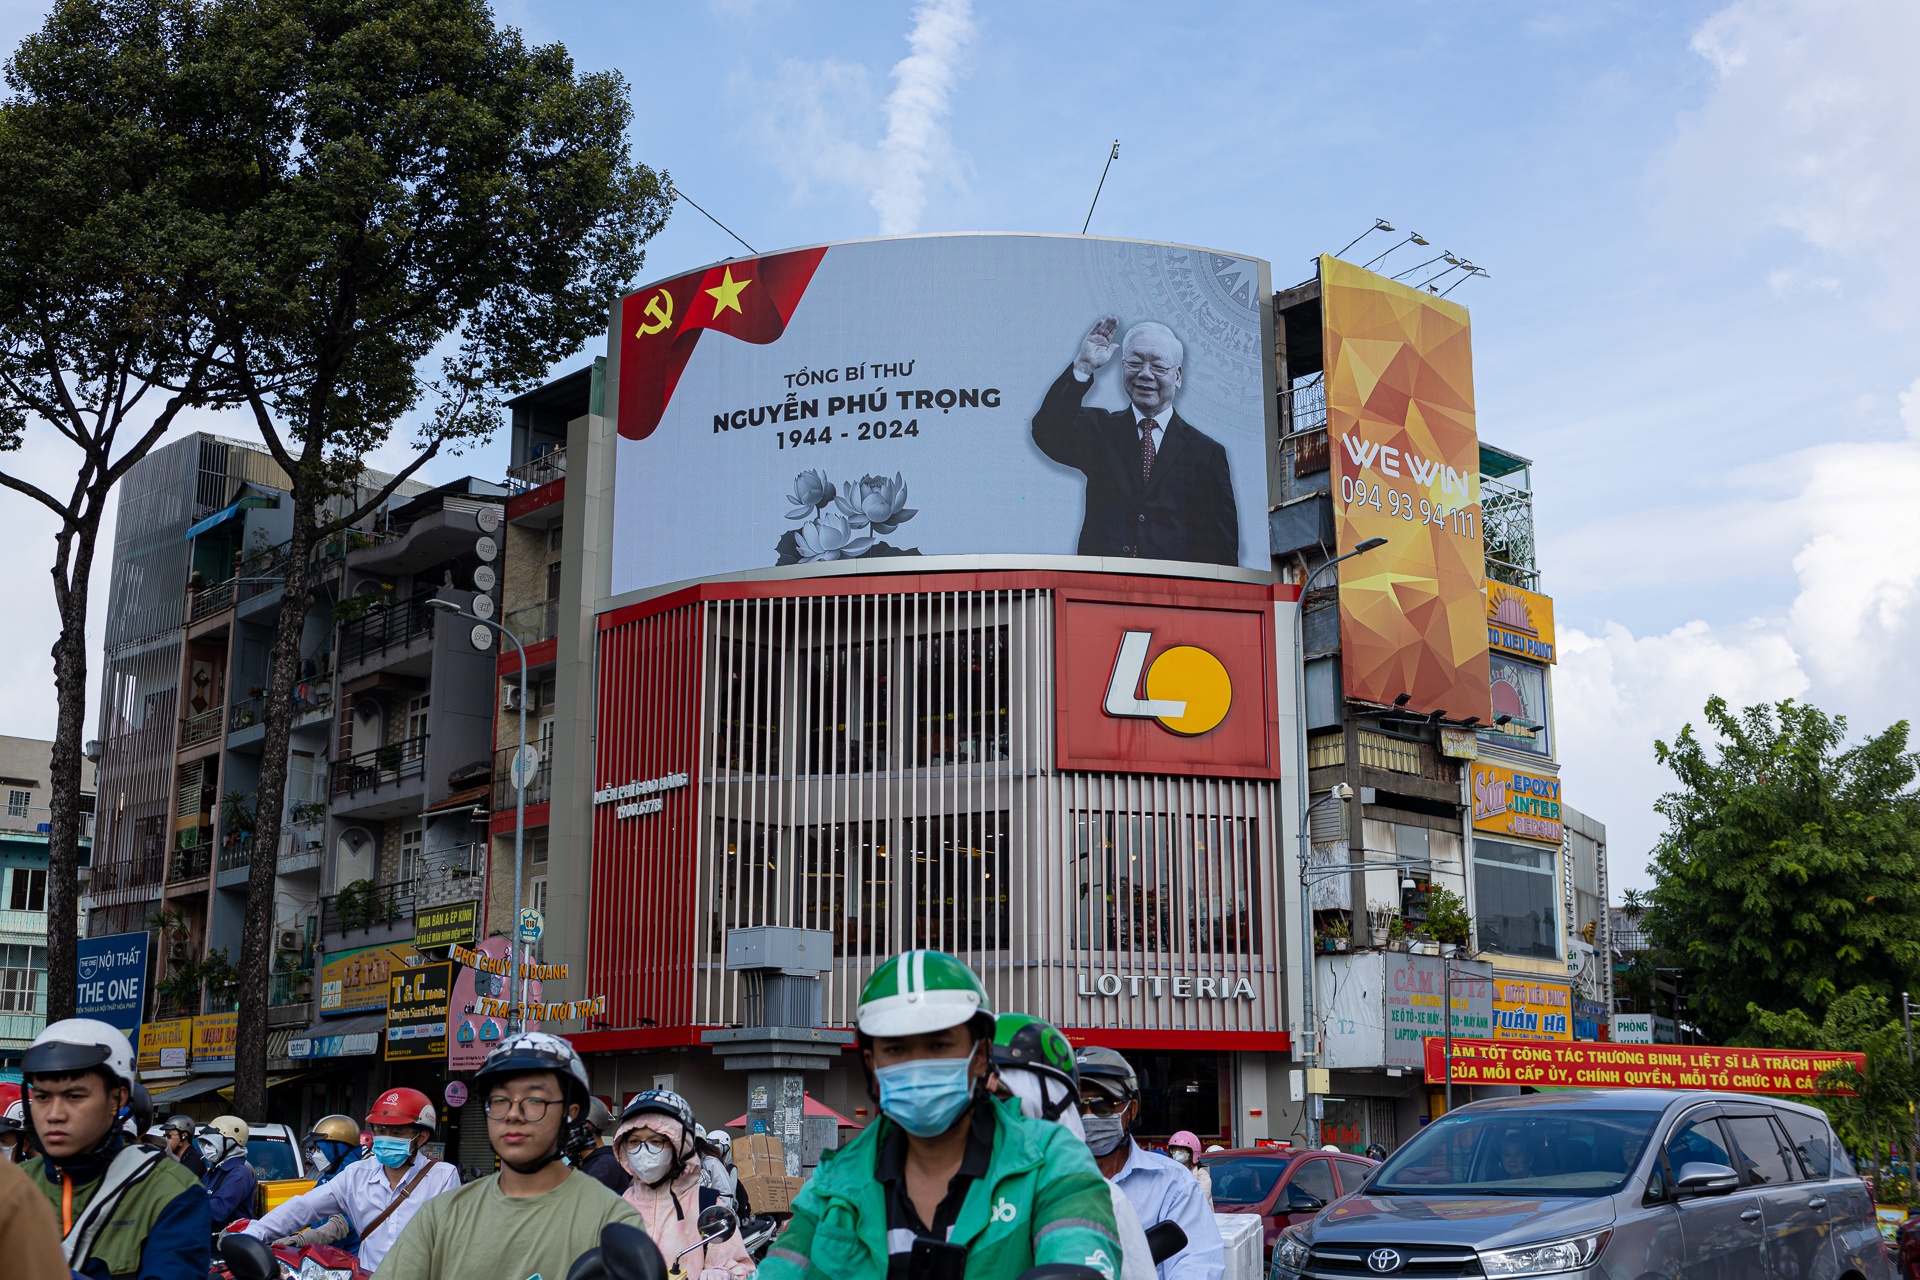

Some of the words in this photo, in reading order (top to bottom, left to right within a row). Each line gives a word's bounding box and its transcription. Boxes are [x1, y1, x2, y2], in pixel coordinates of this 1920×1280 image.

[784, 366, 838, 388] TỔNG
[845, 362, 865, 381] BÍ
[870, 359, 915, 379] THƯ
[713, 392, 818, 433] NGUYỄN
[828, 387, 887, 416] PHÚ
[896, 388, 1001, 414] TRỌNG
[776, 425, 832, 450] 1944
[857, 419, 919, 441] 2024
[1342, 432, 1400, 478] WE
[1404, 452, 1468, 499] WIN
[481, 514, 495, 524] SPA
[1341, 475, 1382, 512] 094
[1388, 489, 1413, 521] 93
[1419, 499, 1445, 531] 94
[1450, 508, 1475, 539] 111
[479, 543, 494, 554] THÚ
[1502, 631, 1524, 653] KIEU
[1527, 639, 1553, 660] PAINT
[594, 783, 618, 804] MIỄN
[618, 780, 636, 799] PHÍ
[636, 779, 658, 795] GIAO
[660, 772, 688, 790] HÀNG
[1513, 774, 1559, 799] EPOXY
[1513, 794, 1560, 820] INTER
[1514, 816, 1562, 840] REDSUN
[419, 916, 431, 928] MUA
[431, 914, 443, 927] BÁN
[449, 911, 457, 923] ÉP
[458, 908, 472, 922] KÍNH
[98, 950, 114, 971] NỘI
[117, 946, 140, 966] THẤT
[480, 956, 526, 978] CHUYN
[530, 964, 568, 980] DOANH
[1077, 973, 1257, 1000] LOTTERIA
[1393, 956, 1433, 994] CẦM
[78, 982, 105, 1004] THE
[108, 978, 139, 1001] ONE
[1546, 990, 1567, 1007] PAINT
[410, 1006, 428, 1018] Smart
[482, 997, 524, 1020] TRAG
[528, 1001, 548, 1021] TRÍ
[550, 1000, 572, 1024] NỘI
[575, 994, 605, 1017] THẤT
[1391, 1010, 1399, 1021] XE
[1400, 1008, 1405, 1021] Ô
[1493, 1006, 1538, 1031] TUẤN
[1543, 1012, 1567, 1034] HÀ
[1338, 1019, 1355, 1035] T2
[1617, 1019, 1649, 1032] PHÒNG
[1479, 1043, 1507, 1060] TỐT
[1512, 1046, 1552, 1062] CÔNG
[1554, 1046, 1584, 1063] TÁC
[1587, 1049, 1644, 1065] THƯƠNG
[1648, 1053, 1686, 1068] BINH,
[1690, 1053, 1721, 1068] LIỆT
[1725, 1054, 1739, 1068] SĨ
[1743, 1054, 1760, 1069] LÀ
[1764, 1055, 1808, 1071] TRÁCH
[1450, 1062, 1478, 1079] CỦA
[1483, 1062, 1512, 1079] MỖI
[1515, 1063, 1544, 1080] CẤP
[1548, 1065, 1573, 1084] ỦY,
[1576, 1065, 1620, 1082] CHÍNH
[1624, 1067, 1676, 1087] QUYỀN,
[1680, 1068, 1706, 1086] MỖI
[1709, 1069, 1728, 1086] TỔ
[1732, 1073, 1770, 1088] CHỨC
[1773, 1073, 1792, 1088] VÀ
[1796, 1074, 1813, 1089] CÁ
